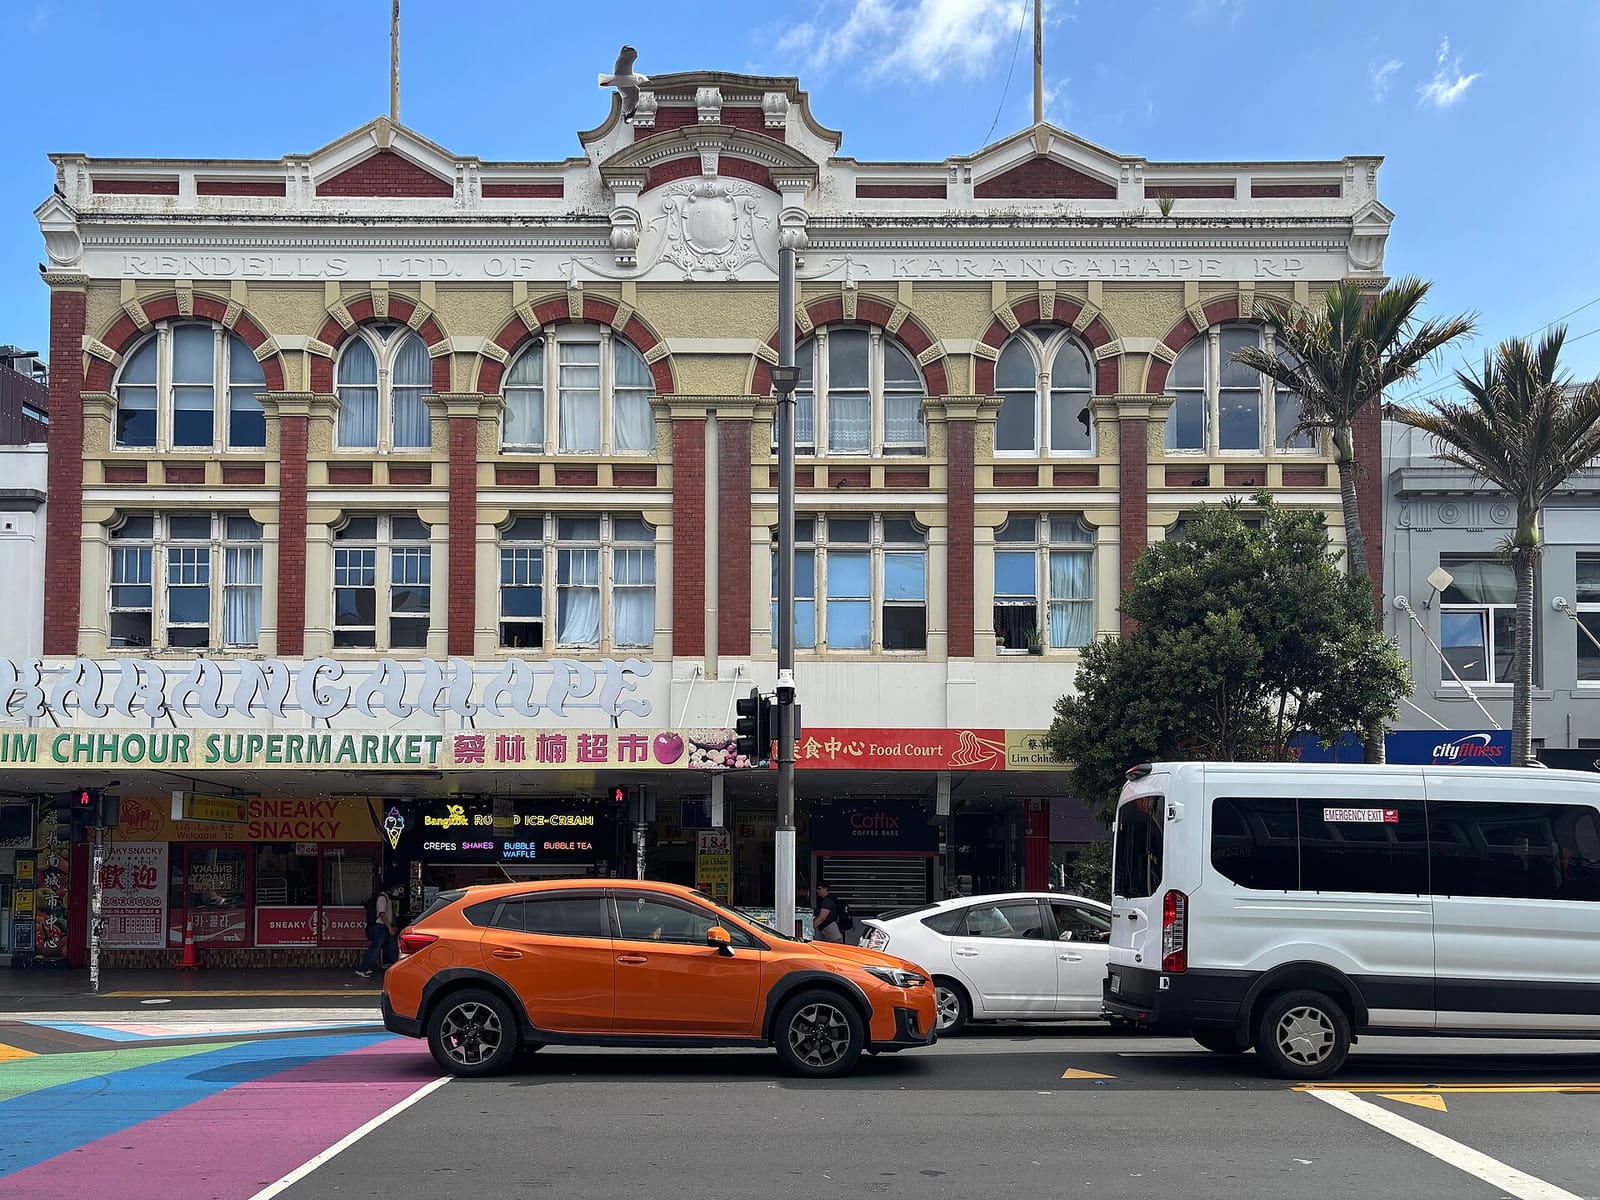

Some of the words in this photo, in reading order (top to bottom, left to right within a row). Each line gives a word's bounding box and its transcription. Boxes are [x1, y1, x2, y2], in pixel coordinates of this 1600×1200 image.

[122, 255, 349, 276] RENDELLS
[377, 256, 463, 277] LTD.
[483, 256, 536, 277] OF
[891, 257, 1224, 279] KARANGAHAPE
[52, 733, 190, 764] CHHOUR
[205, 733, 443, 764] SUPERMARKET
[453, 733, 649, 764] 蔡林楠超市
[869, 743, 901, 757] Food
[904, 743, 944, 757] Court
[1011, 753, 1029, 763] Lim
[248, 800, 341, 818] SNEAKY
[1325, 809, 1366, 821] EMERGENCY
[1367, 810, 1382, 821] EXIT
[474, 814, 521, 826] ROD
[524, 814, 594, 826] ICE-CREAM
[849, 812, 900, 829] Coffix
[176, 831, 217, 839] Welcome
[225, 831, 234, 839] to
[247, 821, 341, 839] SNACKY
[423, 842, 457, 851] CREPES
[461, 841, 495, 850] SHAKES
[503, 841, 536, 850] BUBBLE
[543, 841, 575, 850] BUBBLE
[577, 841, 593, 850] TEA
[701, 836, 729, 849] 184
[502, 850, 536, 859] WAFFLE
[270, 921, 307, 929] SNEAKY
[331, 921, 367, 929] SNACKY
